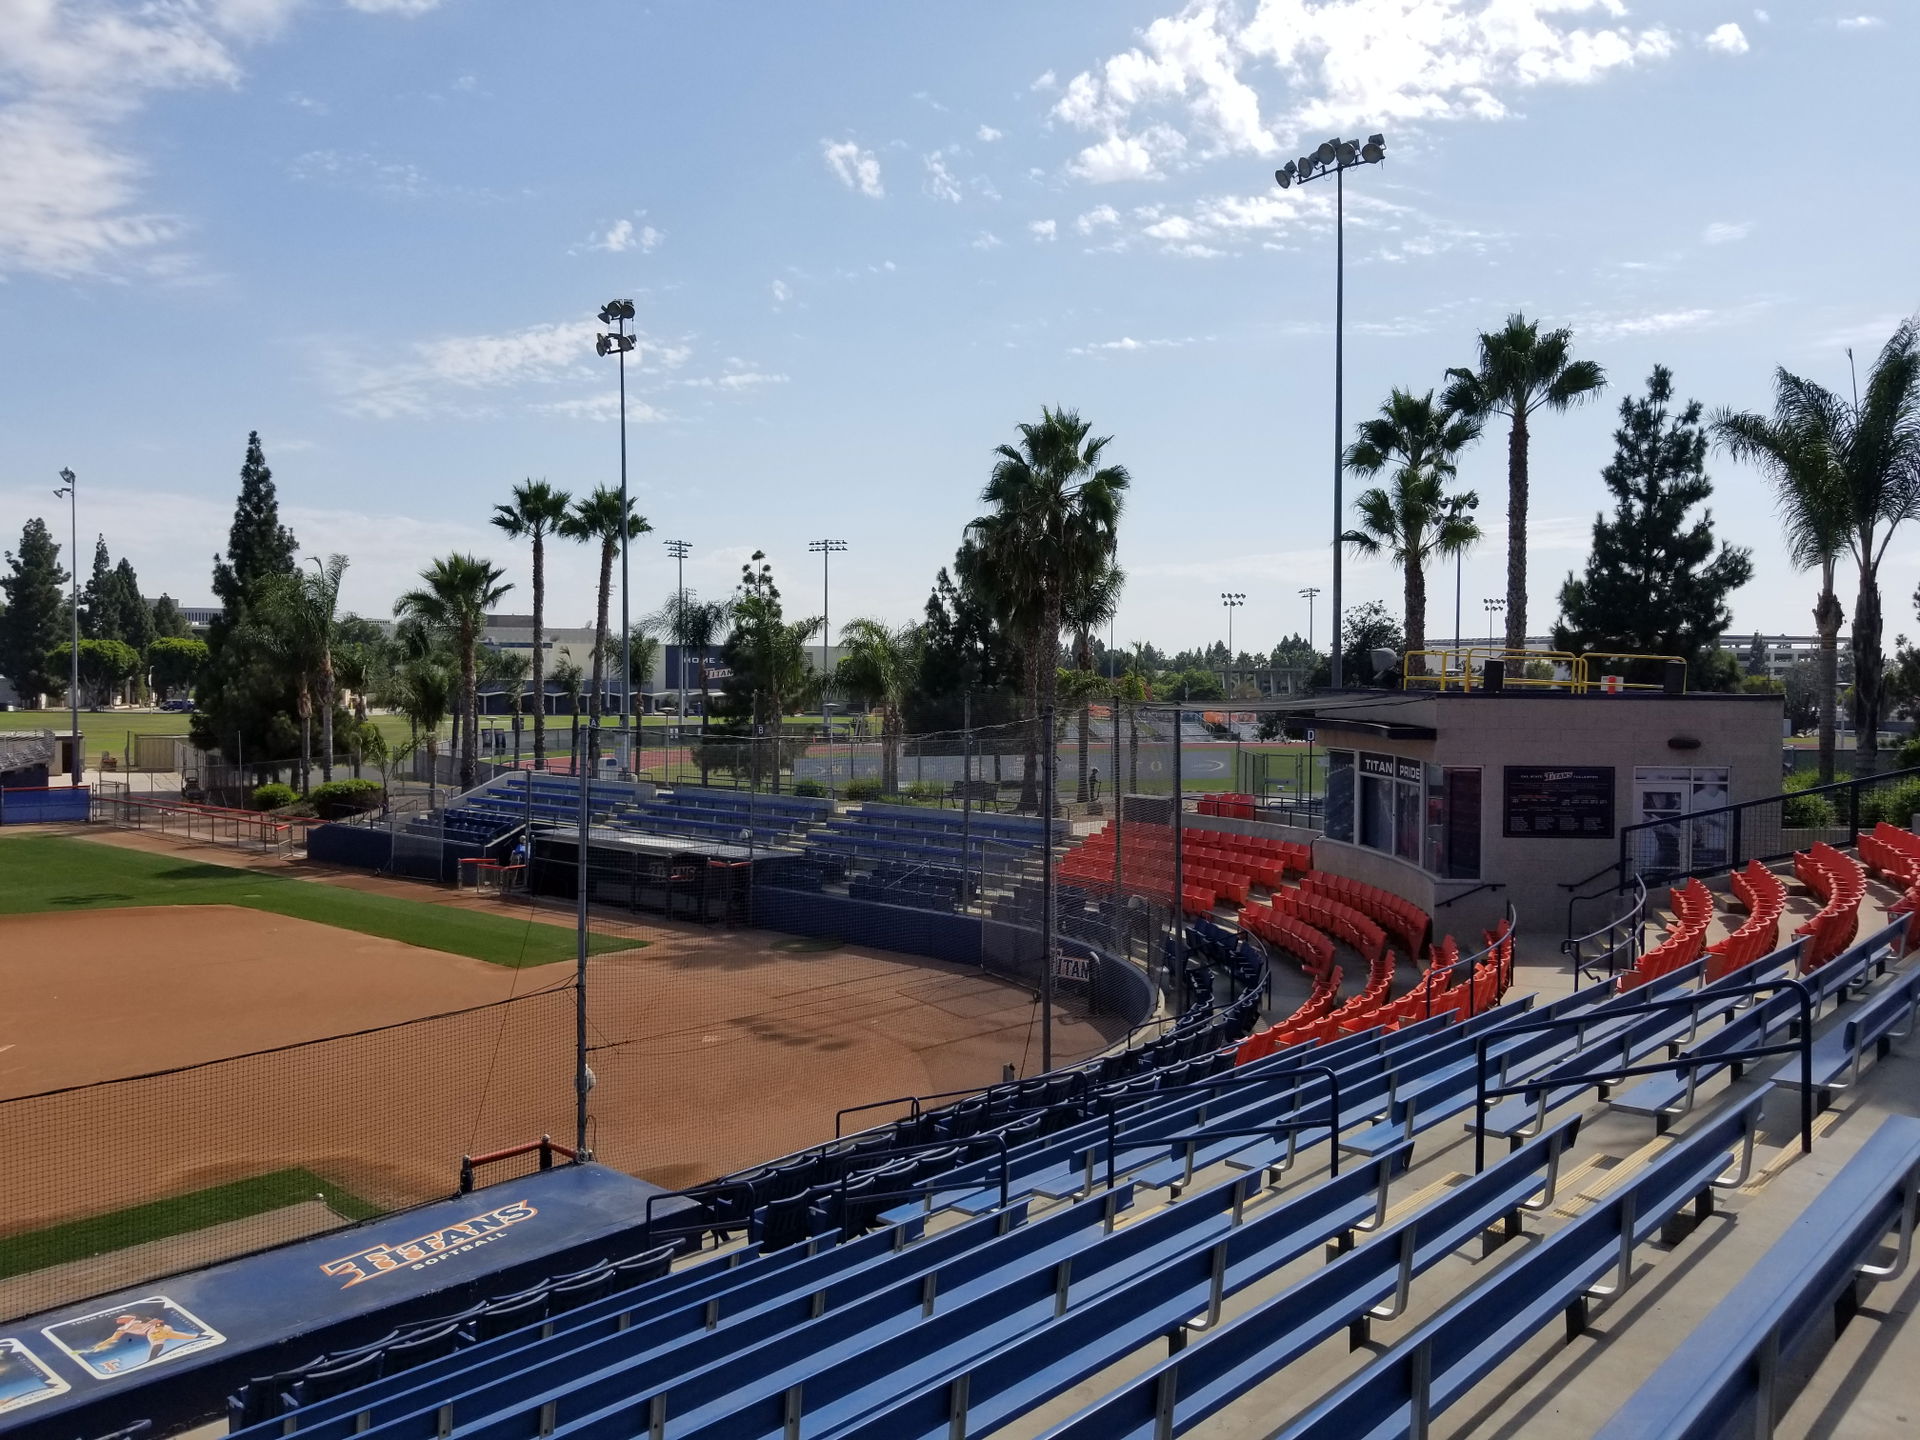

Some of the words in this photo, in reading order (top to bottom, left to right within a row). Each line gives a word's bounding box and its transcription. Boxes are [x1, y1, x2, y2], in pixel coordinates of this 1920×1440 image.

[1307, 730, 1315, 741] D
[1365, 759, 1393, 774] TITAN
[1400, 765, 1420, 780] PRIDE
[319, 1199, 539, 1290] TITANS
[410, 1231, 508, 1271] SOFTBALL
